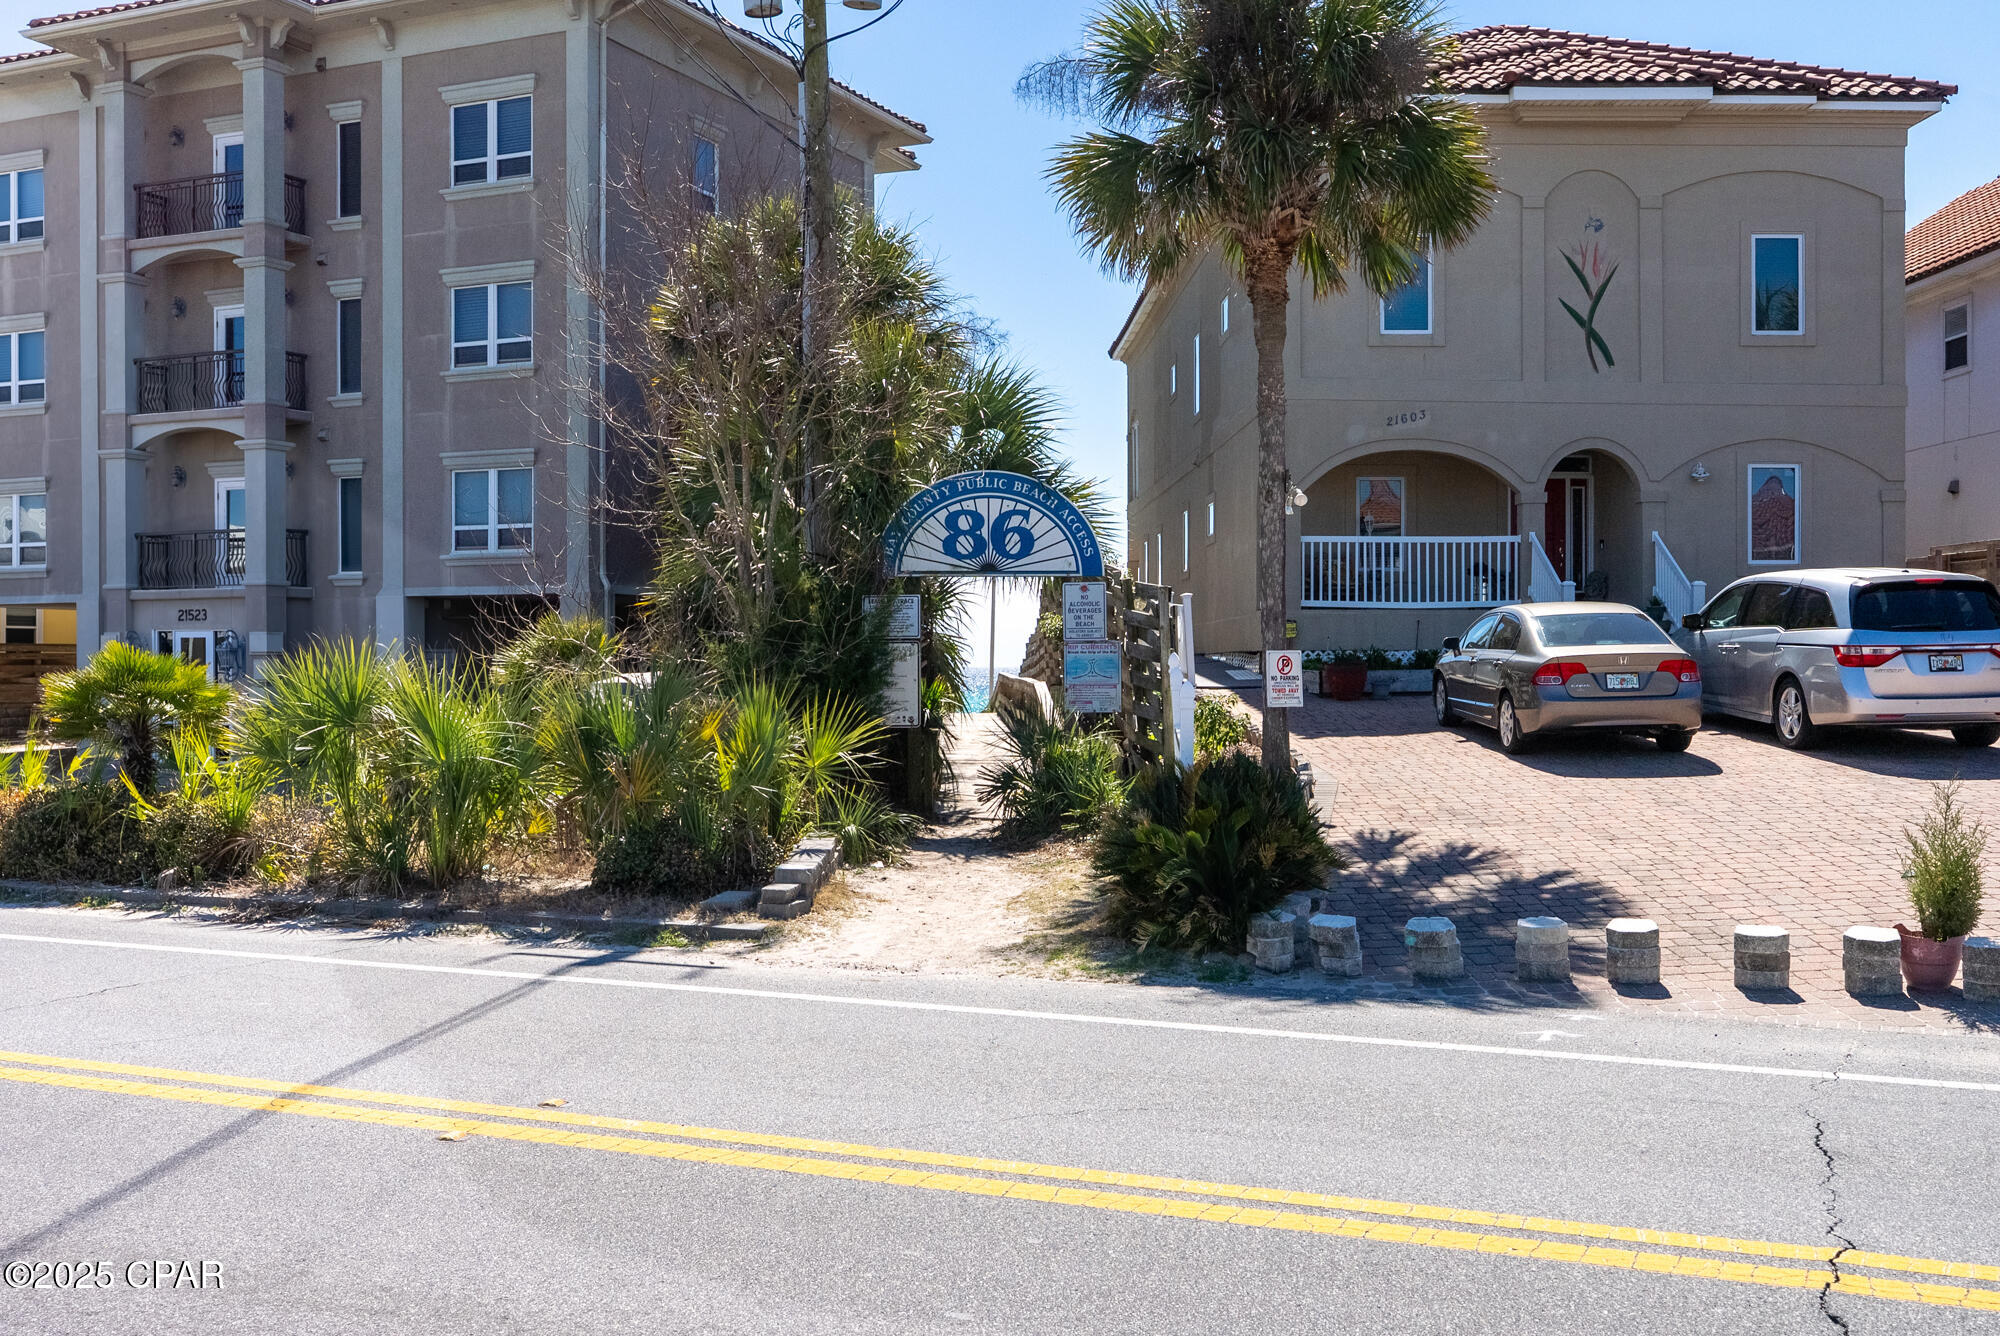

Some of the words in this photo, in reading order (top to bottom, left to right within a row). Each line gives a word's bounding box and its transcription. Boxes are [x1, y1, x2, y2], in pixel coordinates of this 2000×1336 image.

[1386, 409, 1426, 426] 21603
[902, 484, 950, 527] COUNTY
[957, 477, 1007, 492] PUBLIC
[1013, 481, 1059, 509] BEACH
[1058, 509, 1094, 558] ACCESS
[942, 509, 1035, 560] 86
[178, 608, 208, 622] 21523
